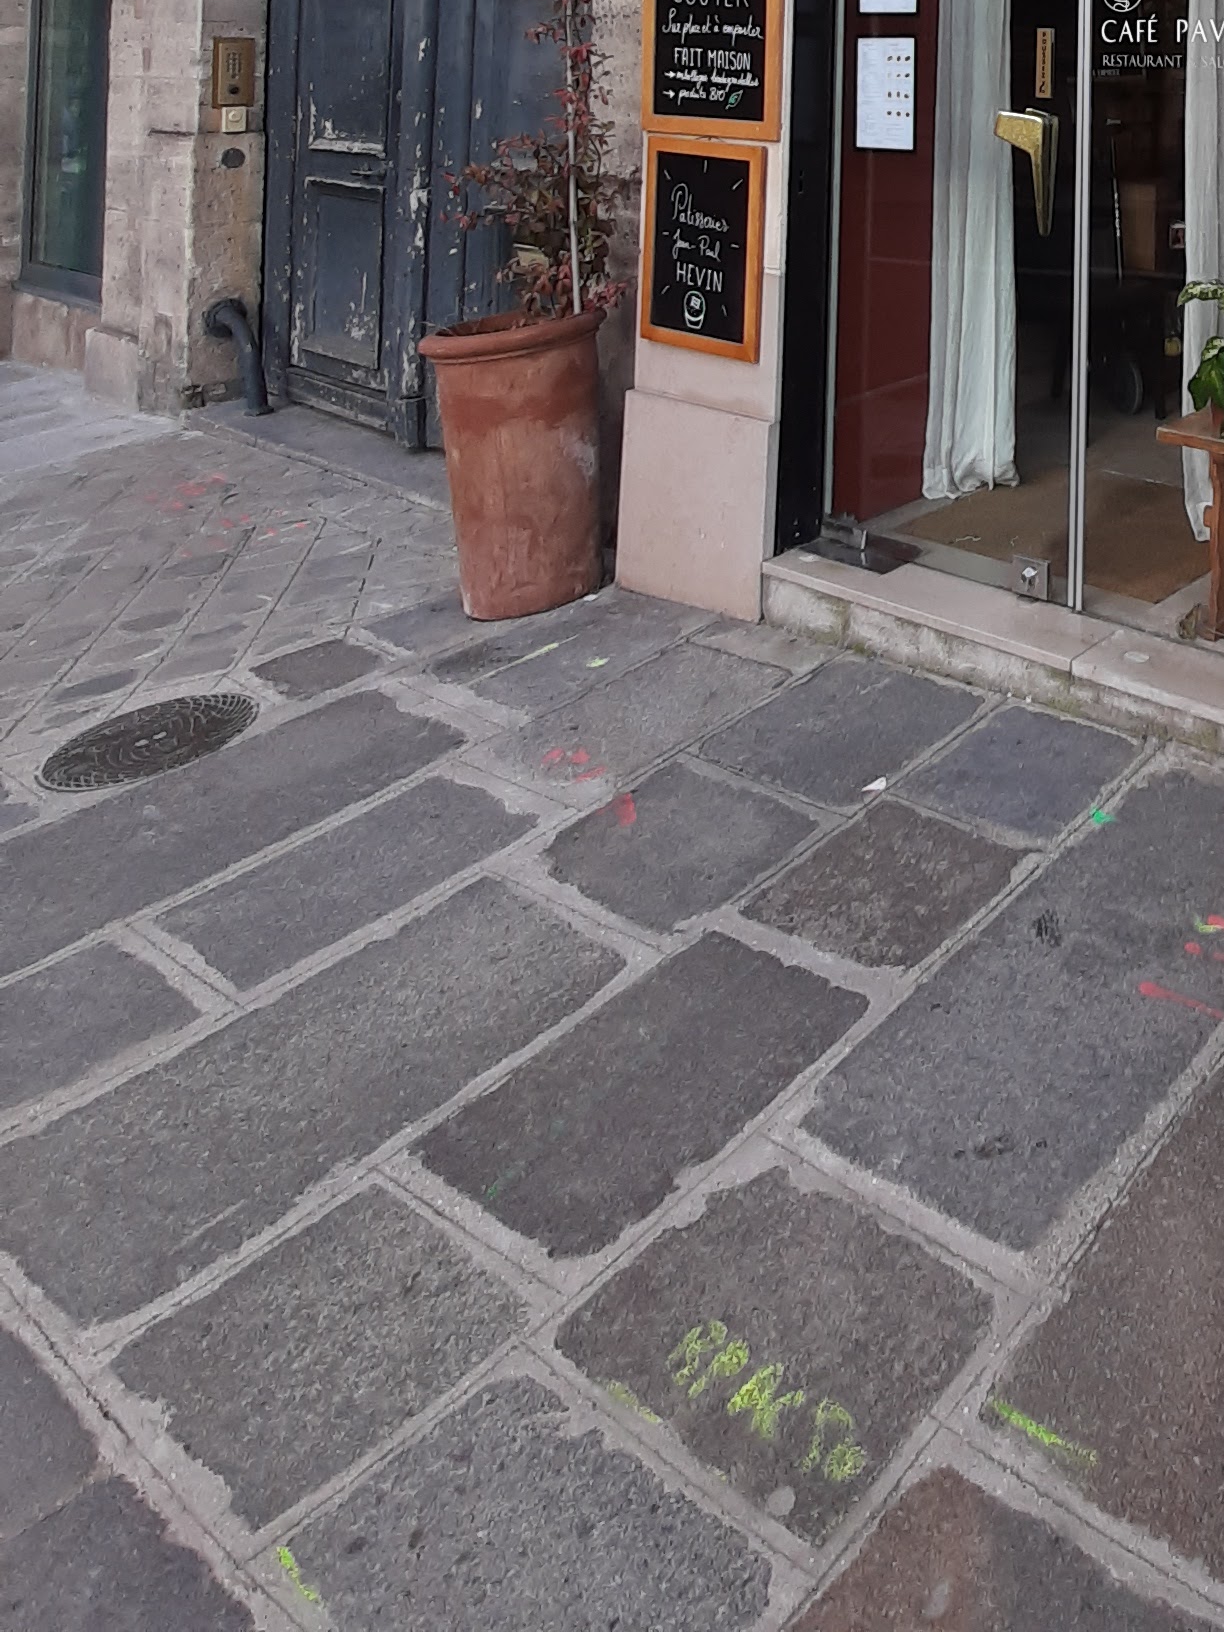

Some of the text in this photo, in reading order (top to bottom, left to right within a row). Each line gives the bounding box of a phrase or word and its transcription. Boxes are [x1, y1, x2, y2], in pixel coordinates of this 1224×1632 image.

[1101, 14, 1158, 44] CAFÉ
[674, 47, 752, 71] FAIT MAISON
[1102, 54, 1183, 69] RESTAURANT
[675, 261, 724, 293] HEVIN
